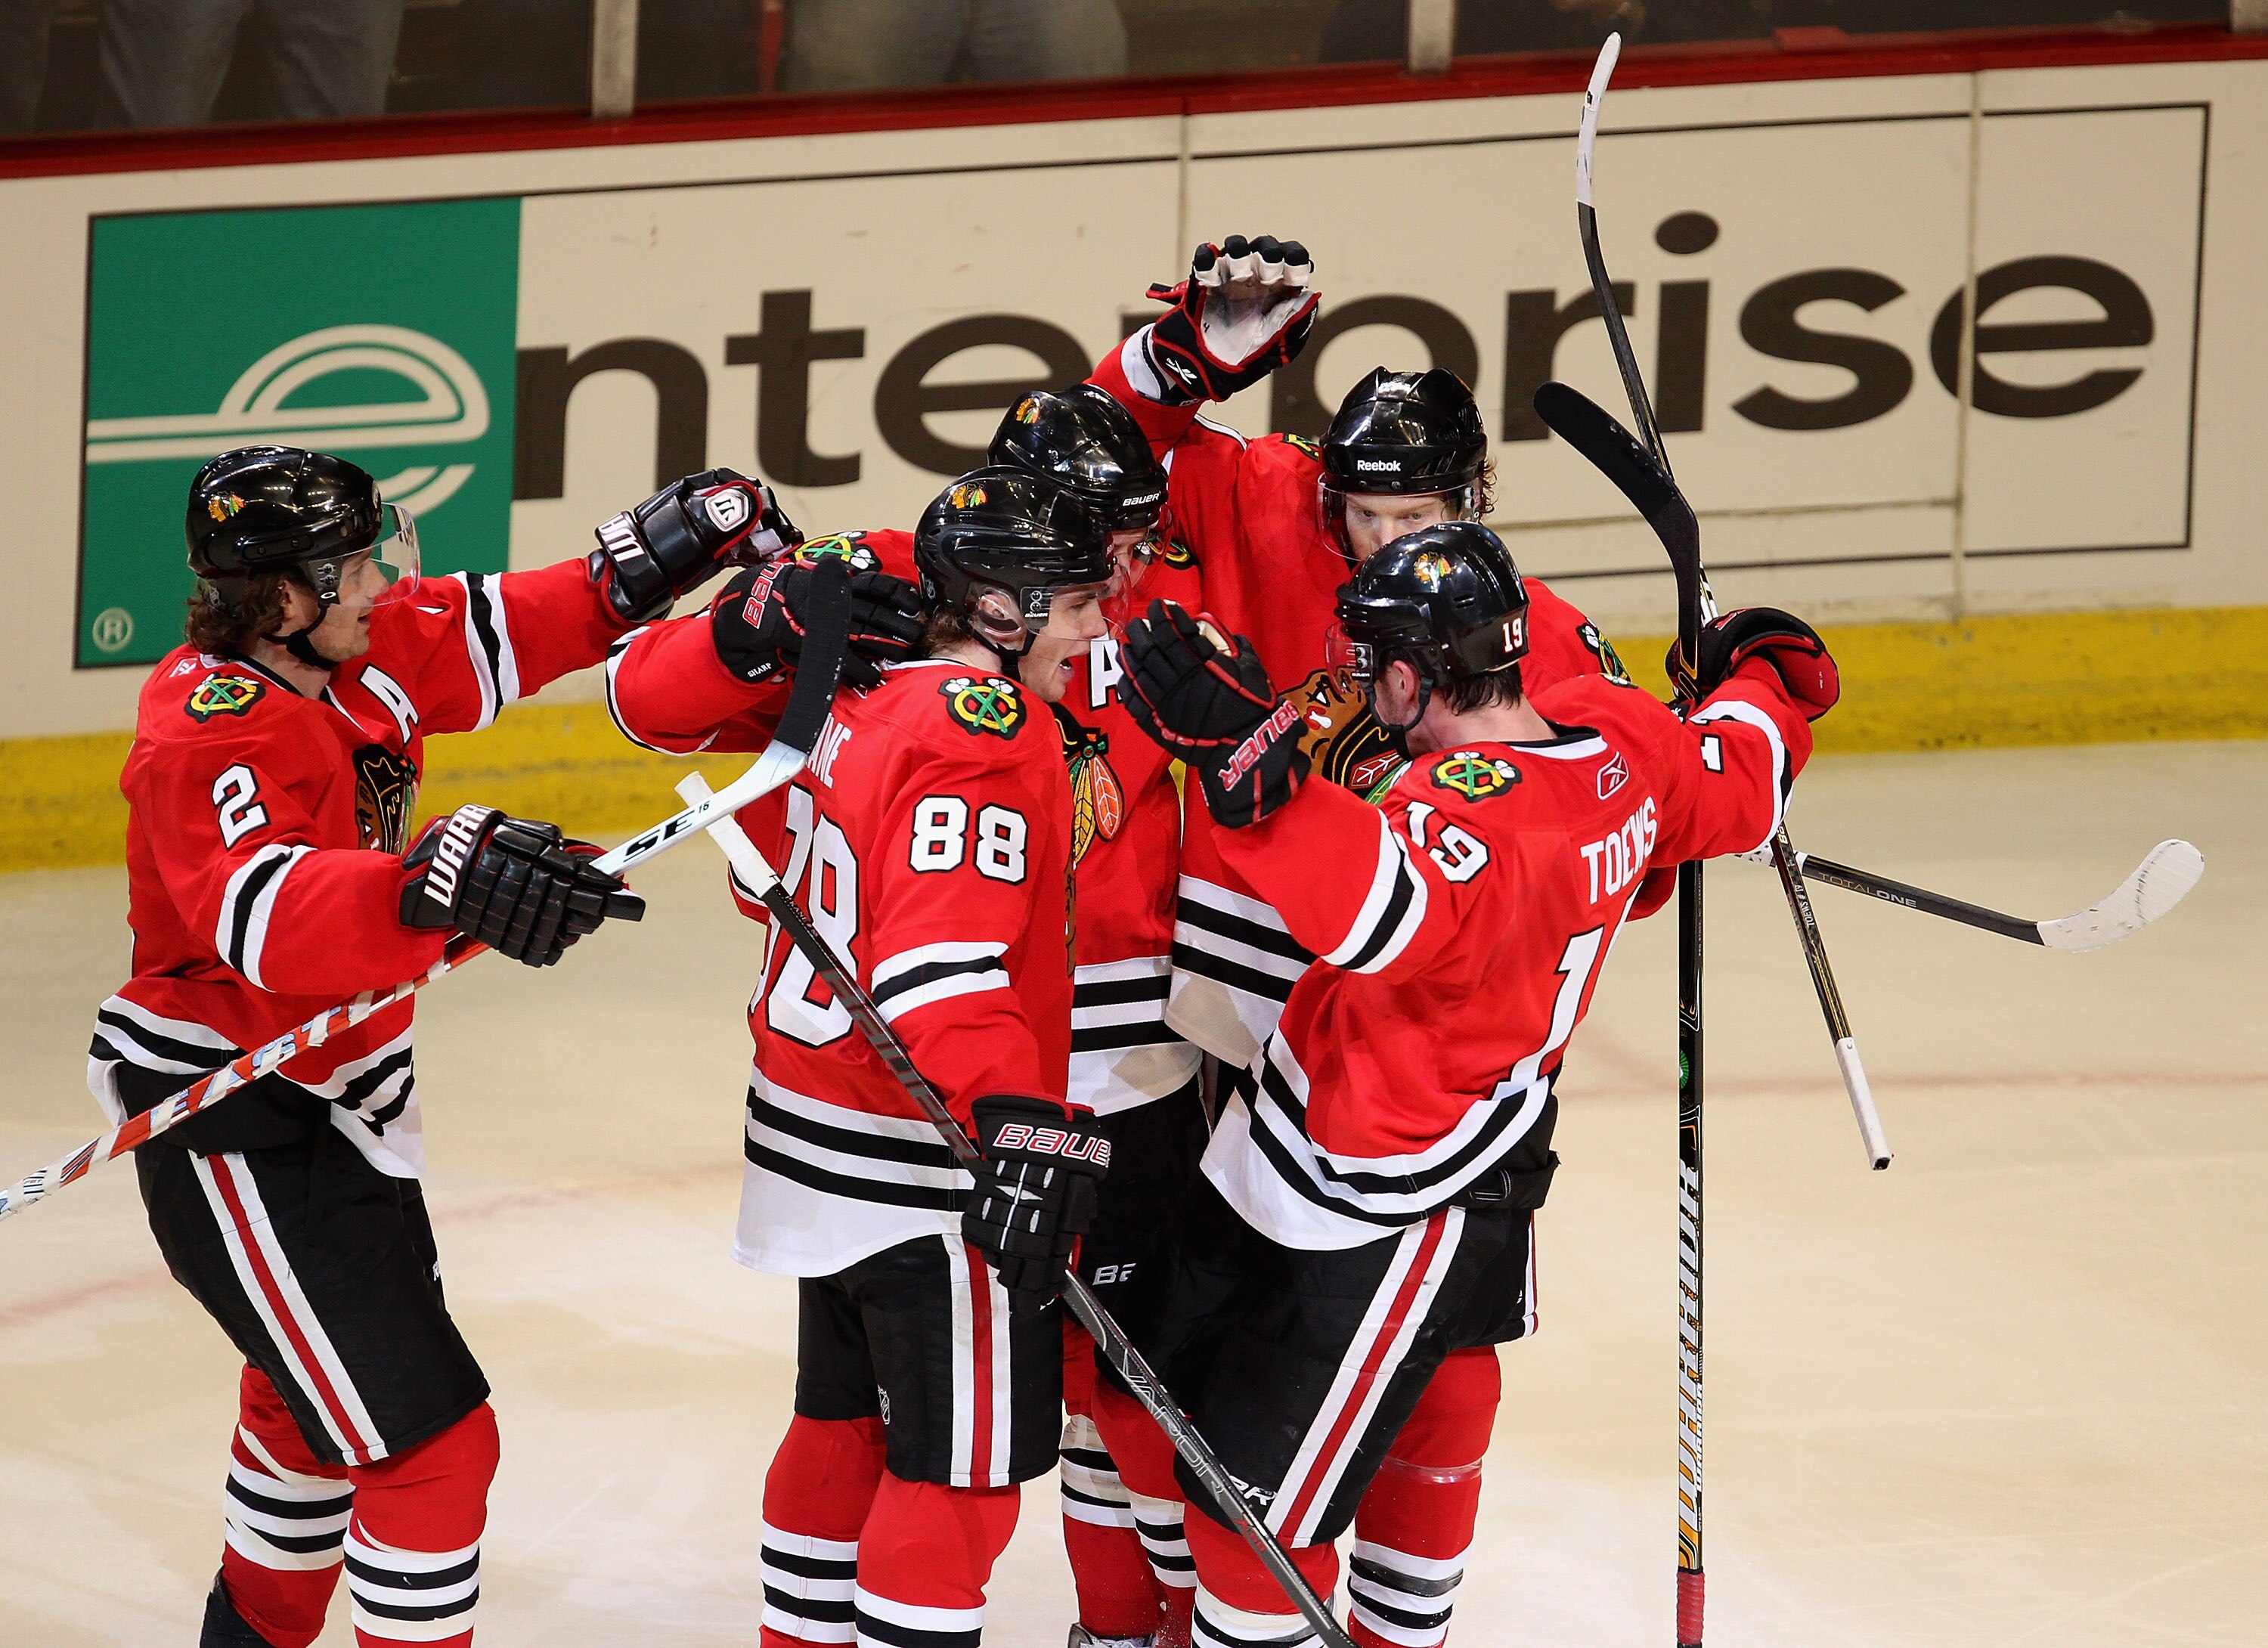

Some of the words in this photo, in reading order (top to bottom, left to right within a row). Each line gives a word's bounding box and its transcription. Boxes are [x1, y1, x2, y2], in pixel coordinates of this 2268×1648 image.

[85, 210, 2158, 522] enteprise
[1356, 459, 1402, 472] Reebok
[746, 661, 773, 679] SHARP
[1089, 632, 1126, 708] A
[1501, 620, 1525, 654] 19
[356, 662, 420, 747] A
[804, 712, 853, 789] ANE
[211, 762, 271, 850] 2
[908, 794, 1028, 886] 88
[1405, 799, 1490, 884] 19
[1580, 795, 1659, 907] TOEWS
